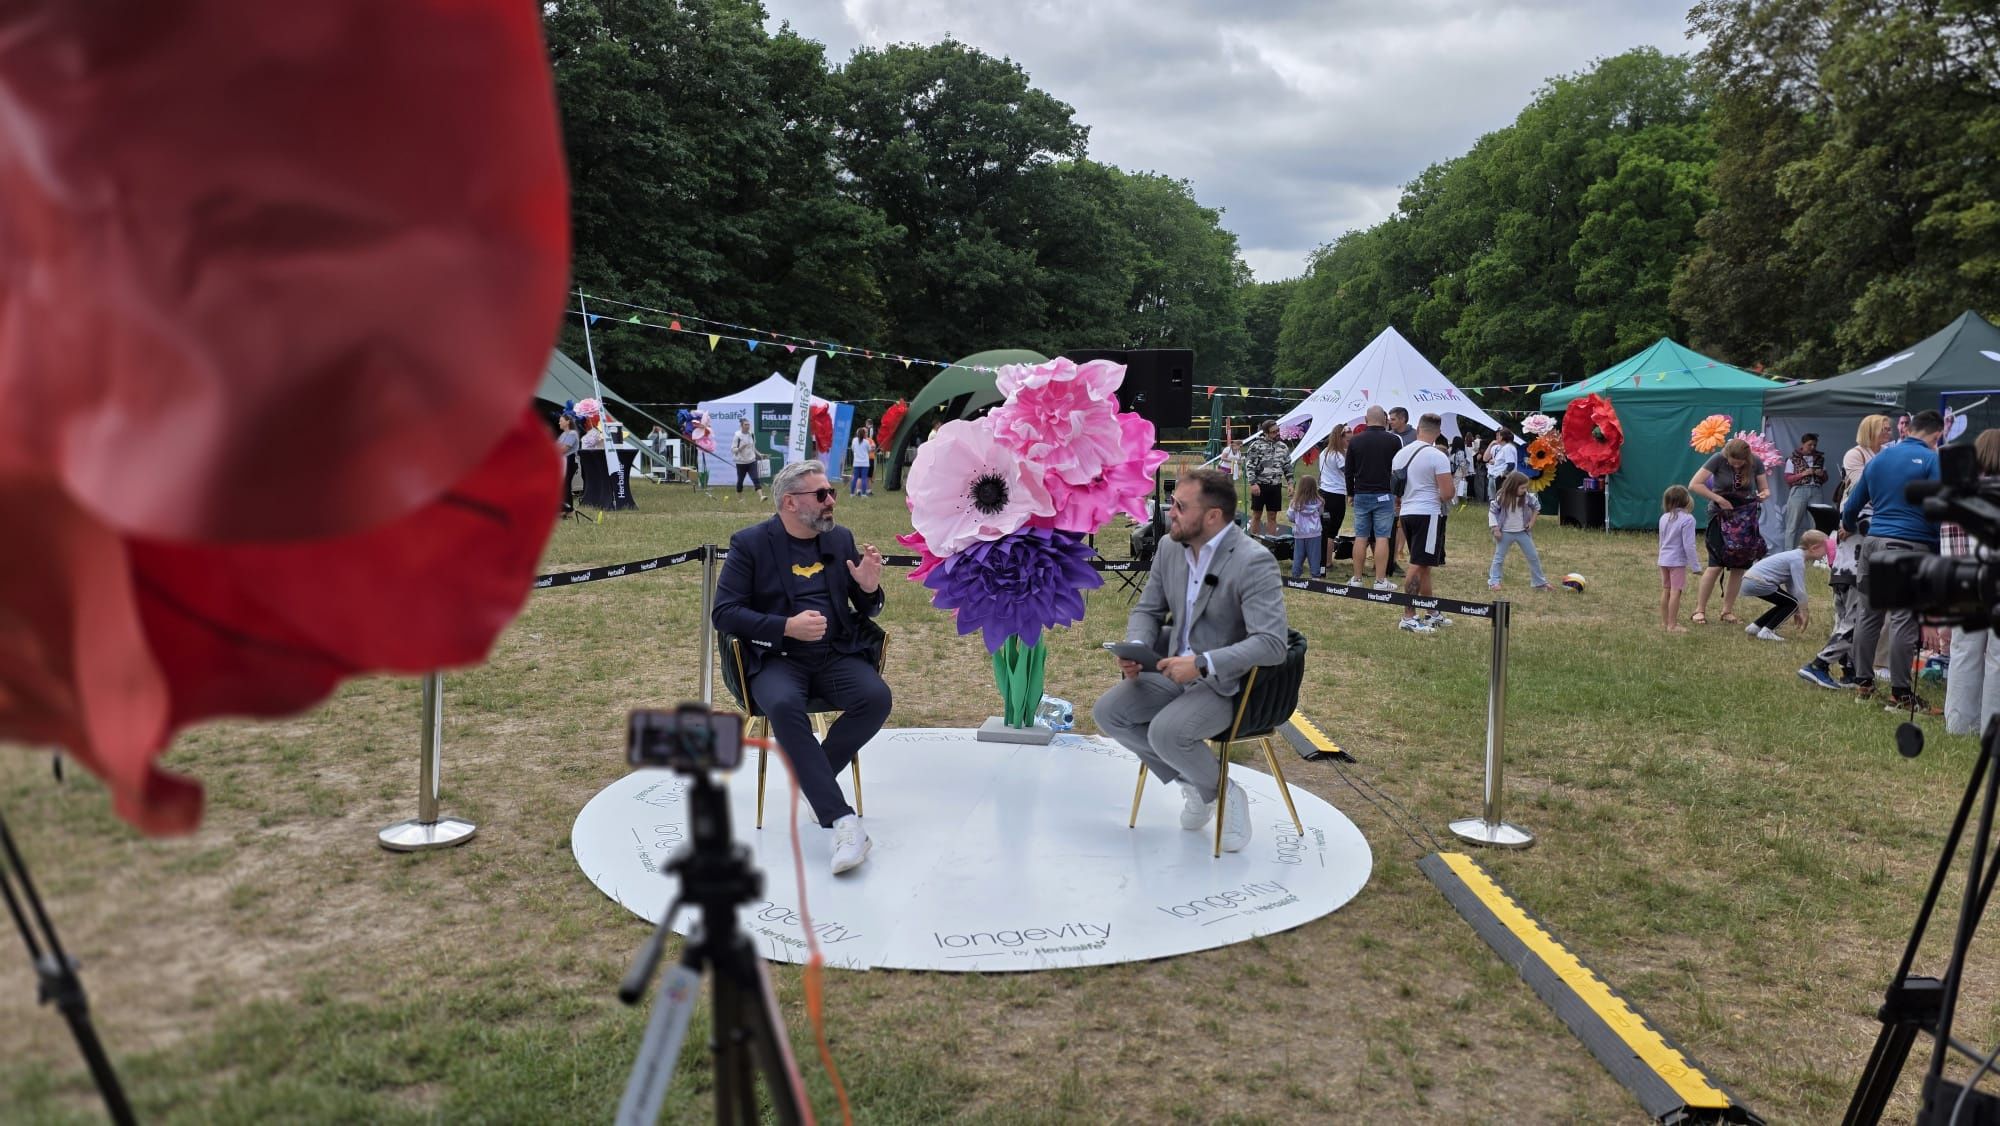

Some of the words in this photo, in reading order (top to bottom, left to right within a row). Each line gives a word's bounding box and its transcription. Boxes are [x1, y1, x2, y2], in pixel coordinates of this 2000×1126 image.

[710, 409, 743, 420] erbalife
[795, 387, 811, 452] Herbalife
[617, 464, 626, 498] Herbalife
[1461, 605, 1489, 616] Herbalife
[1157, 880, 1289, 919] longevity
[757, 901, 863, 944] ngeity
[934, 922, 1111, 948] longevity
[1034, 941, 1104, 956] Herbalife
